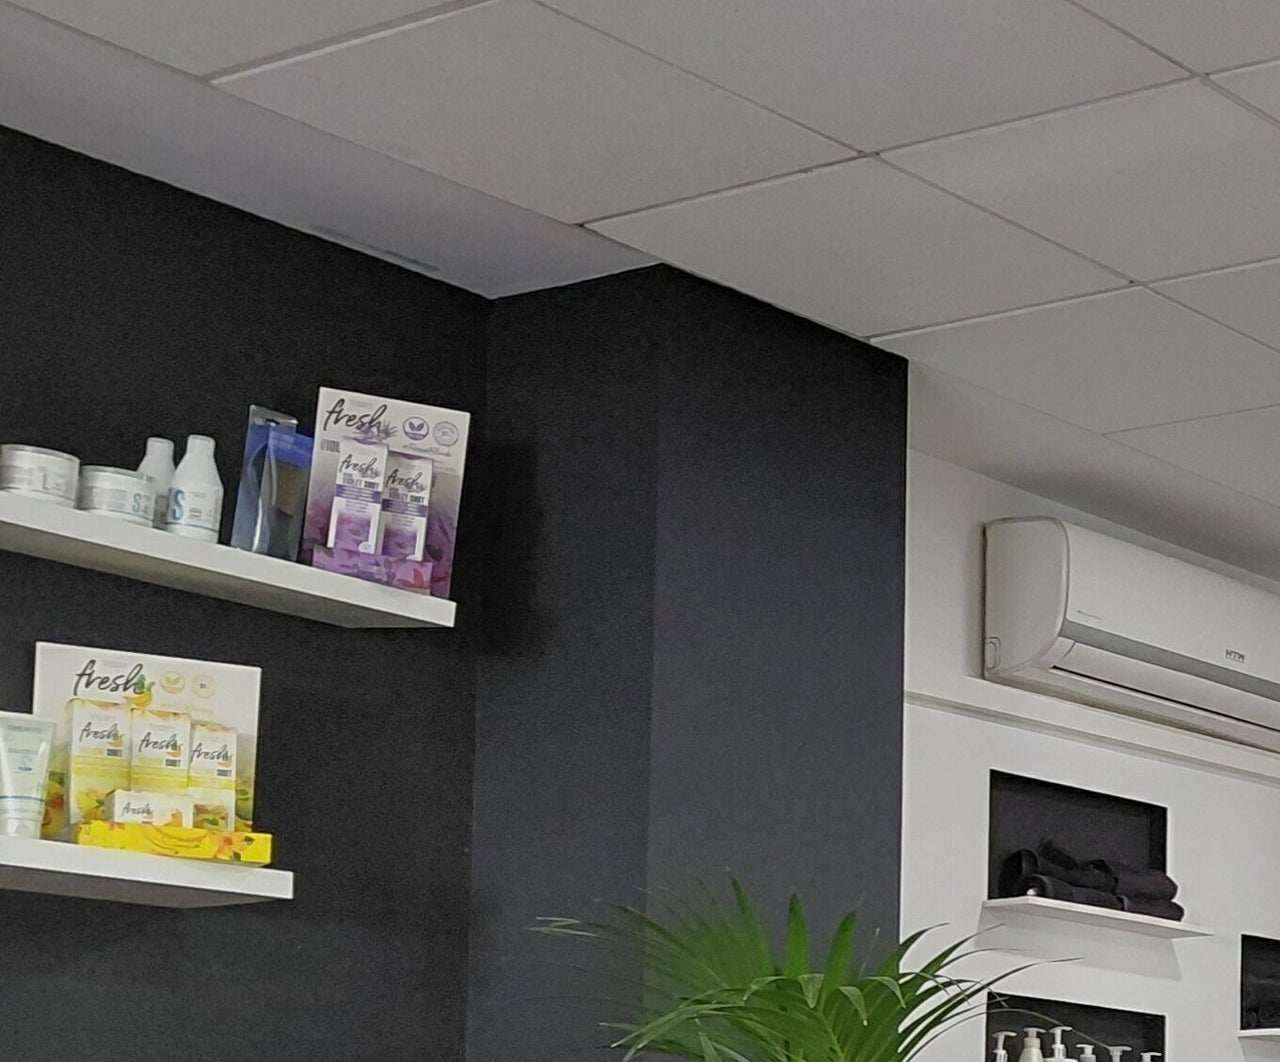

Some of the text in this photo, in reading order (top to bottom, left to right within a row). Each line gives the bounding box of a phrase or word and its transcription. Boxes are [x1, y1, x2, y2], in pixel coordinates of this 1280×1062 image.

[323, 398, 386, 431] fresh
[339, 453, 377, 474] fresh
[385, 468, 422, 488] fresh
[73, 659, 145, 696] fresh
[79, 721, 119, 742] fresh
[138, 731, 178, 753] fresh
[190, 742, 229, 763] fresh
[121, 801, 152, 817] fresh
